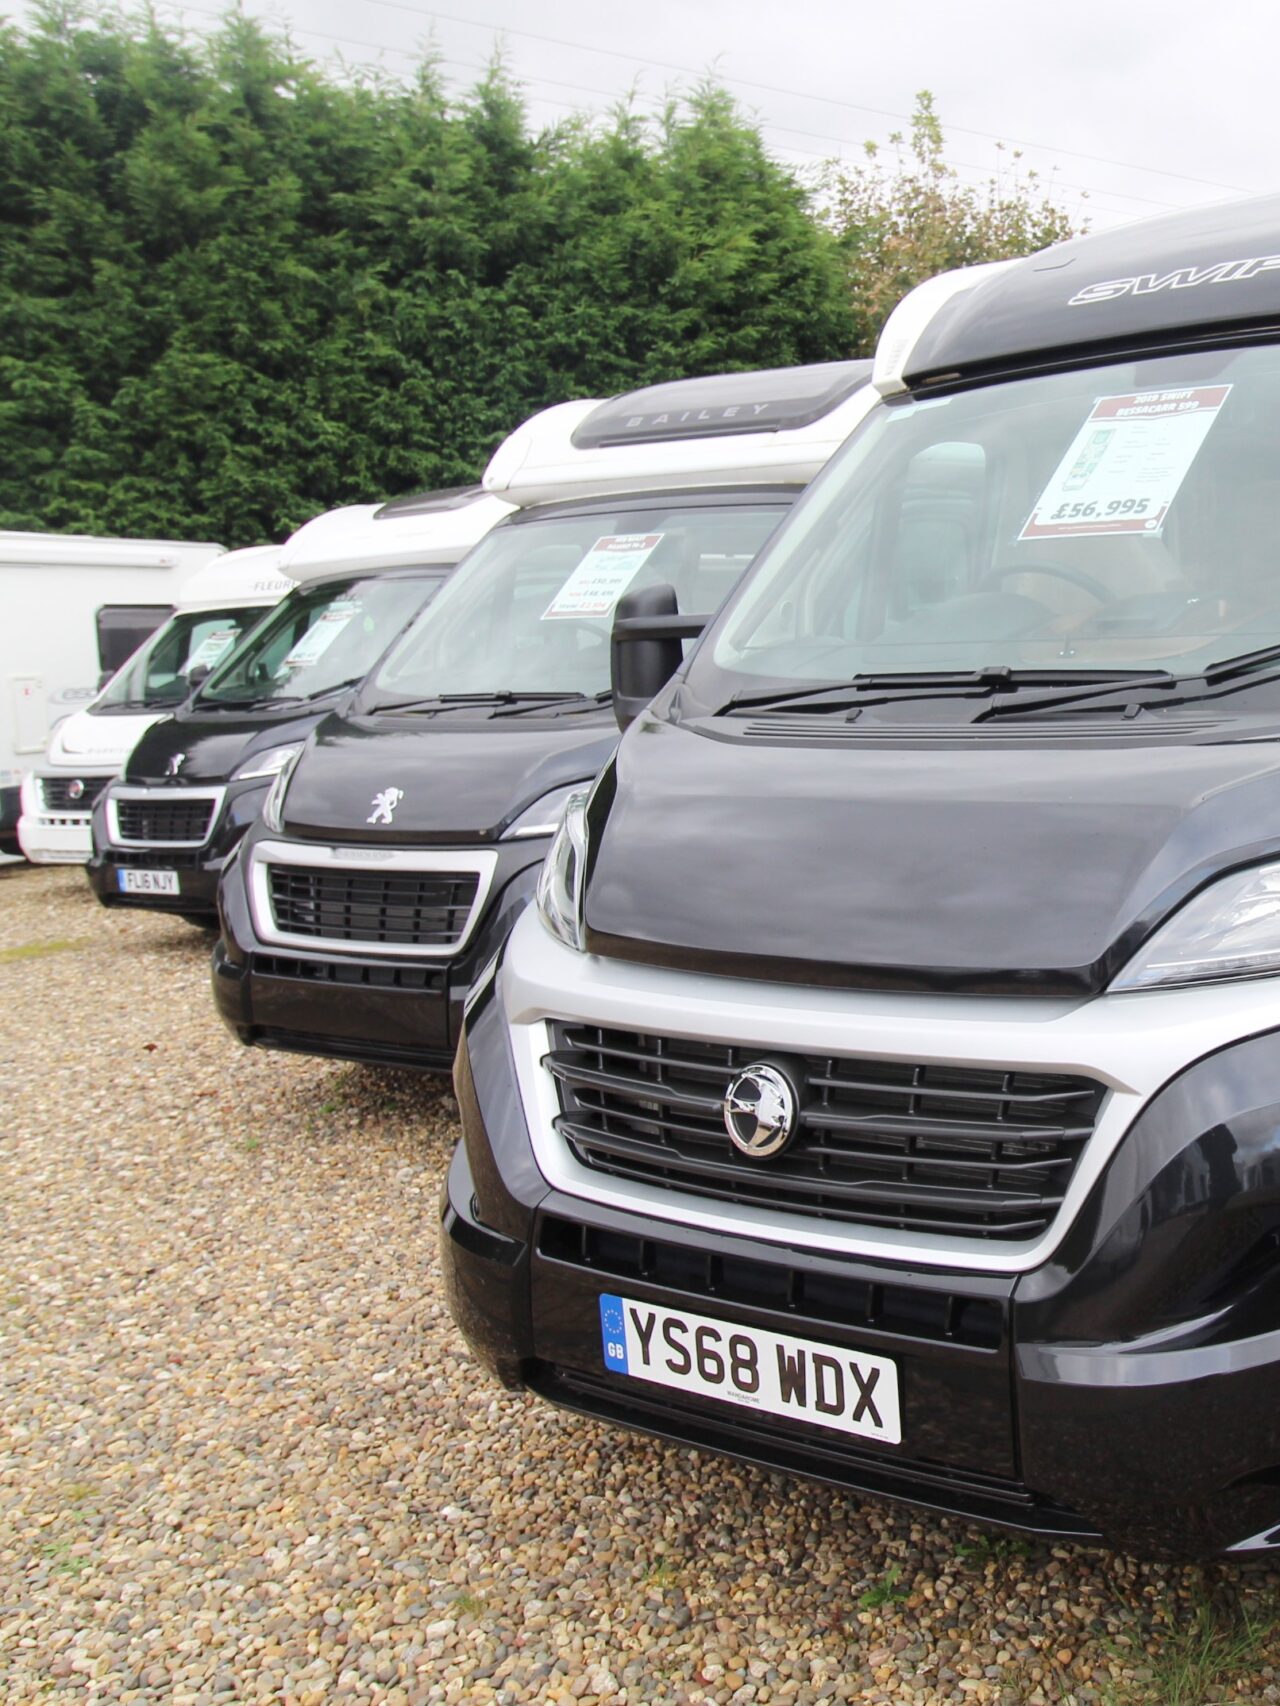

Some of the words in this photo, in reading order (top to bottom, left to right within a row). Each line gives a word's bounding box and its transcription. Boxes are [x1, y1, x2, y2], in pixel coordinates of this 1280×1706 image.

[1160, 390, 1194, 402] SWIFT
[626, 404, 769, 427] BAILEY
[1116, 402, 1176, 417] BESSACARR
[1050, 498, 1151, 520] £56,995
[607, 1341, 624, 1360] GB
[629, 1307, 760, 1393] YS68
[776, 1343, 883, 1428] WDX
